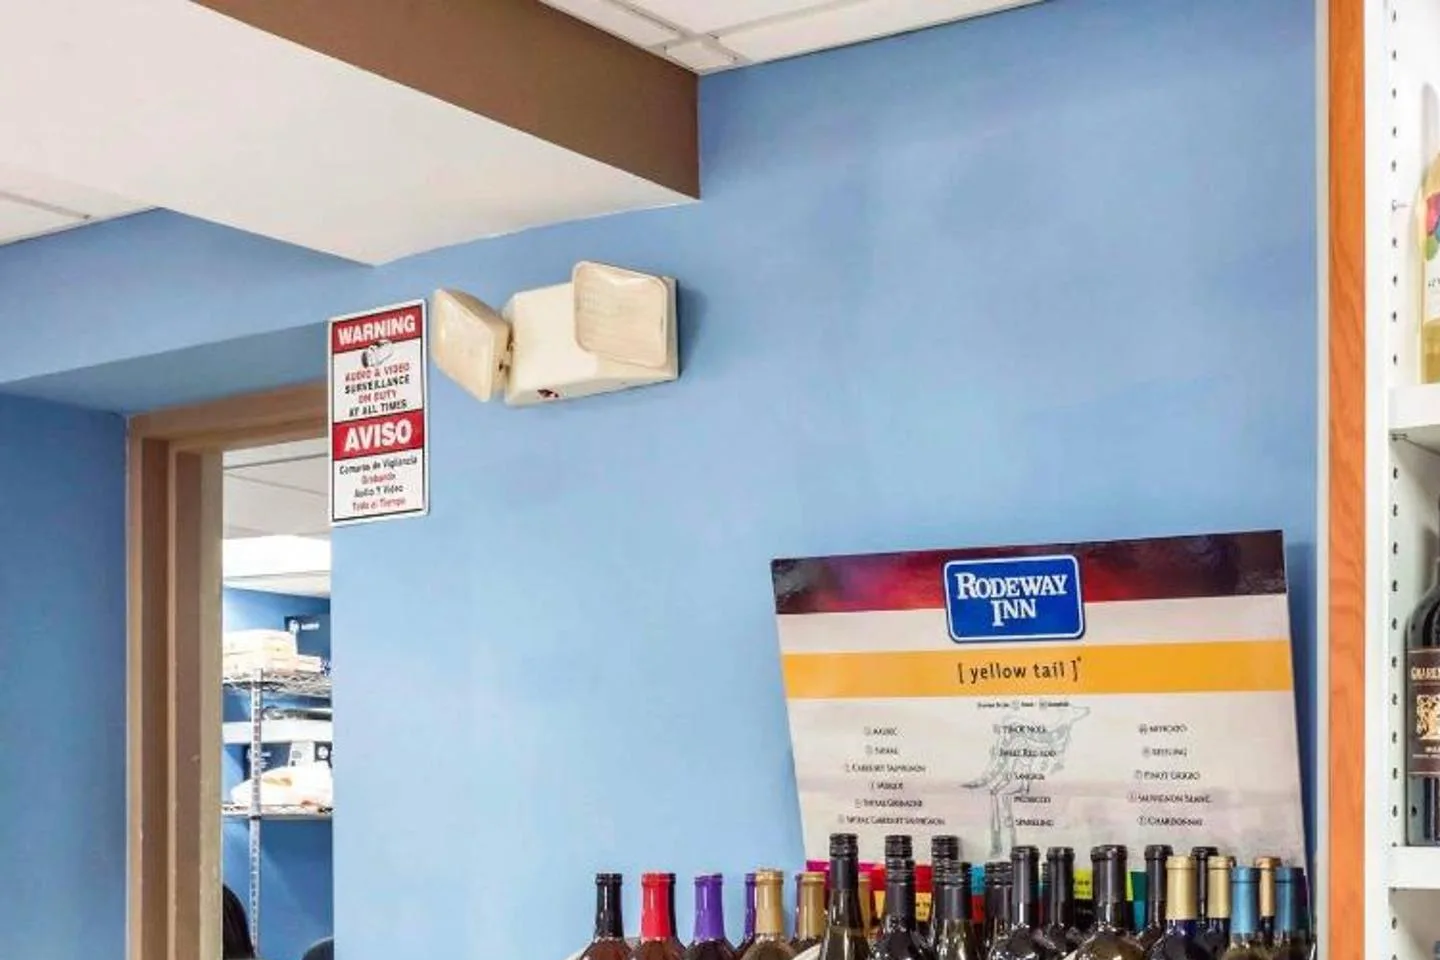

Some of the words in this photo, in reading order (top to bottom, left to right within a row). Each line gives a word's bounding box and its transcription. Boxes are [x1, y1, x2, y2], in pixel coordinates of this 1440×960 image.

[338, 315, 416, 345] WARNING
[345, 368, 372, 382] AUDIO
[384, 362, 410, 376] VIDEO
[344, 374, 411, 394] SURVEILLANCE
[358, 393, 372, 404] ON
[373, 389, 397, 402] DUTY
[362, 402, 378, 415] ALL
[381, 398, 407, 412] TIMES
[343, 418, 412, 452] AVISO
[954, 571, 1069, 600] RODEWAY
[992, 600, 1037, 627] INN
[970, 663, 1027, 683] yellow
[1032, 660, 1066, 679] tail
